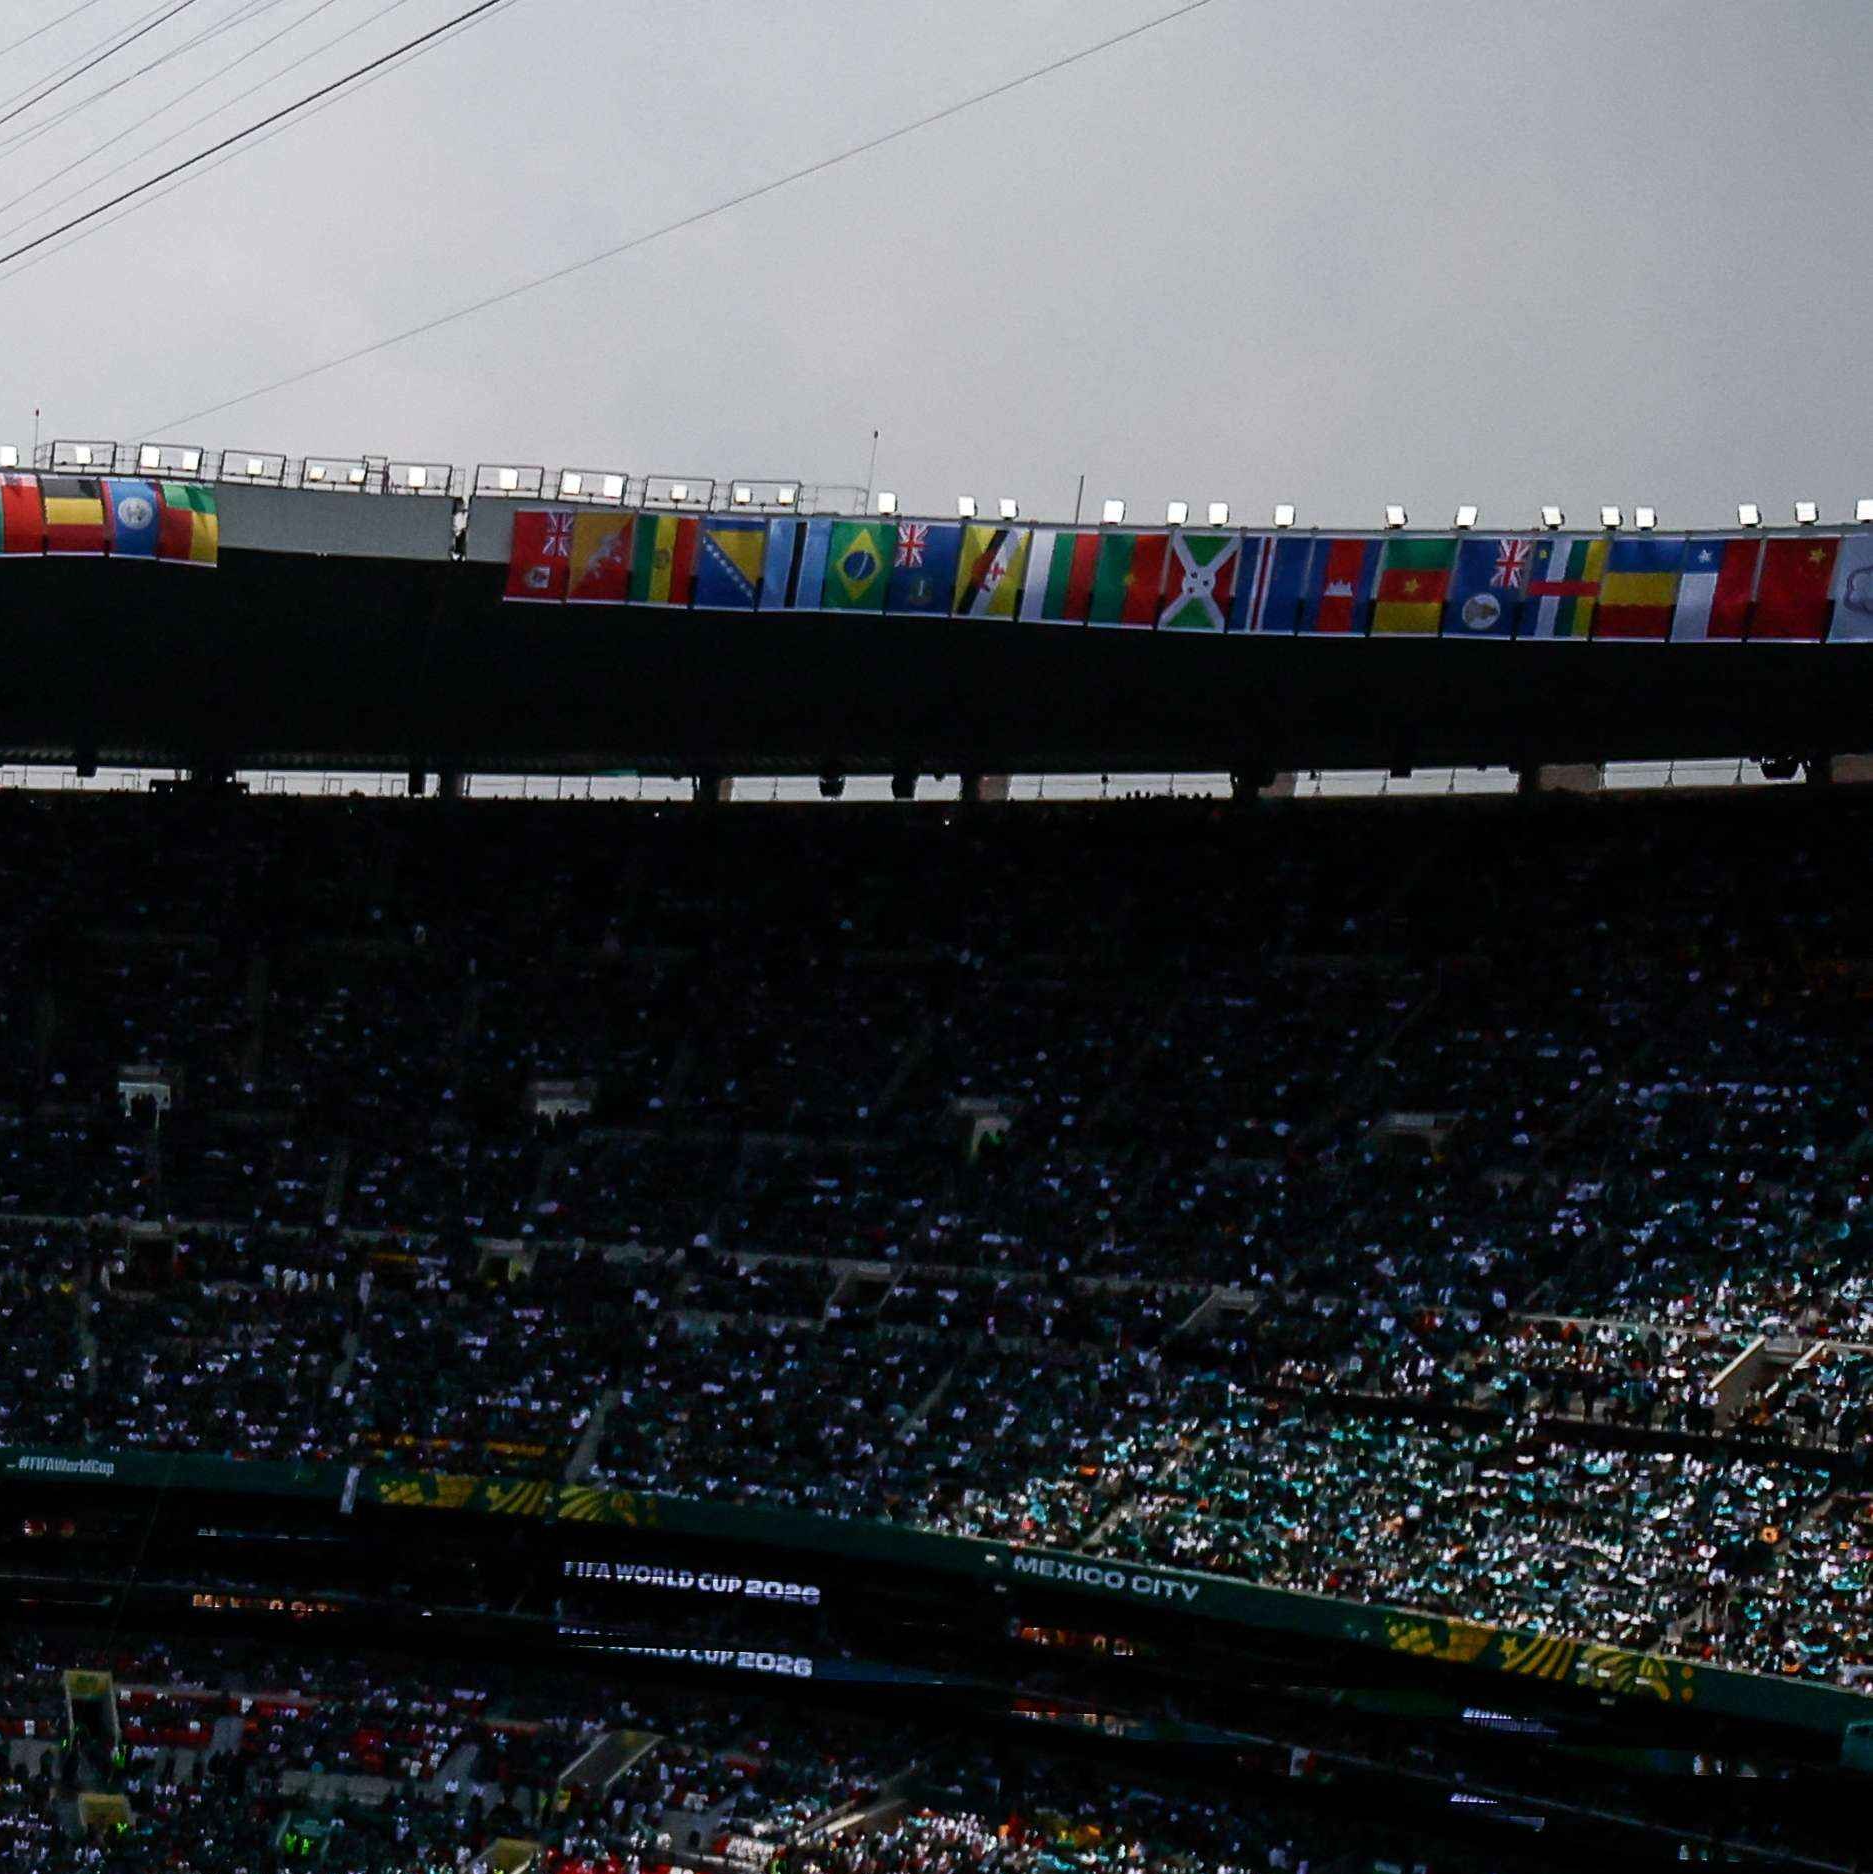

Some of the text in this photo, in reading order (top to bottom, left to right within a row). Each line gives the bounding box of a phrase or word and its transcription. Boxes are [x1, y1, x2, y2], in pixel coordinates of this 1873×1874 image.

[615, 1562, 695, 1589] WORLD
[697, 1574, 743, 1595] CUP
[1012, 1554, 1200, 1602] MEXICO CITY
